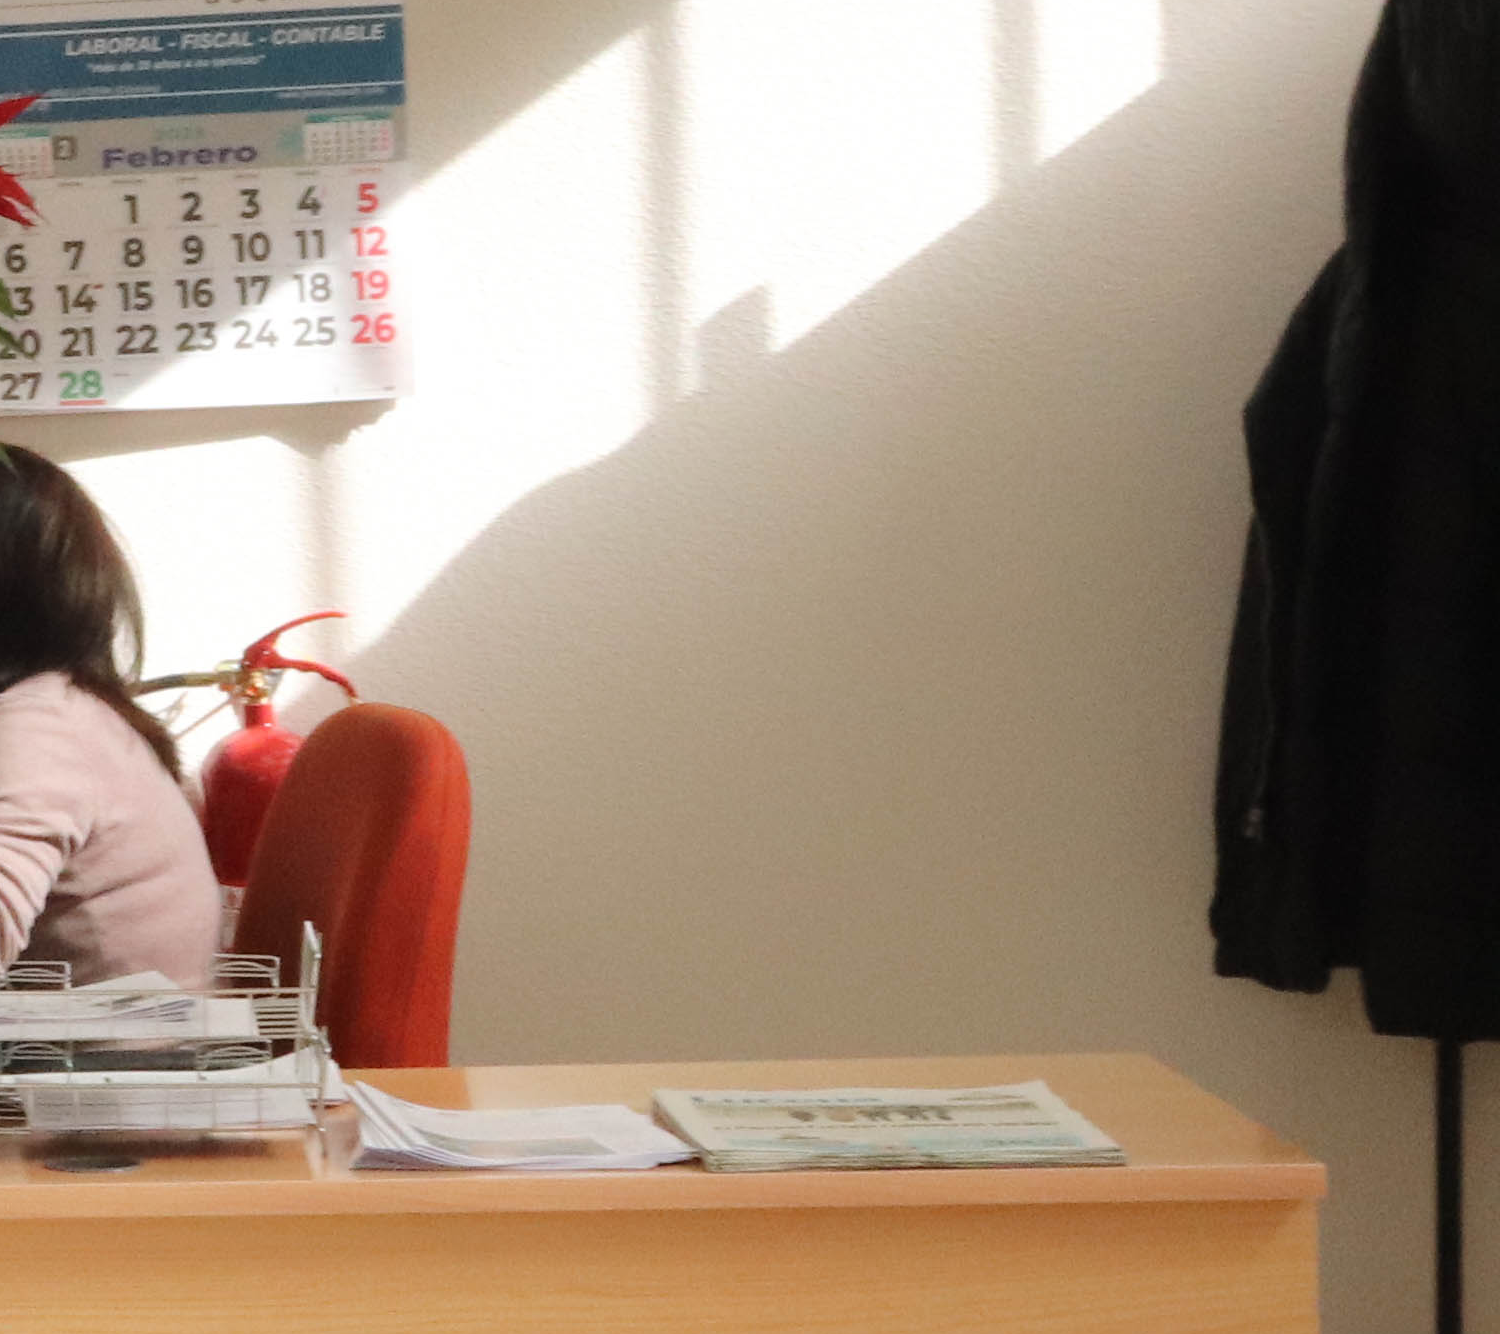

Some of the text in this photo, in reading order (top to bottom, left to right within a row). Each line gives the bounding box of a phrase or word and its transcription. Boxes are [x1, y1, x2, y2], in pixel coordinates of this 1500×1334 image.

[65, 35, 164, 57] LABORAL
[180, 29, 254, 50] FISCAL
[270, 22, 386, 46] CONTABLE
[103, 145, 258, 169] Febrero
[124, 183, 379, 224] 1 2 3 4 5
[5, 226, 389, 274] 6 7 8 9 10 11 12
[56, 283, 98, 315] 14
[117, 281, 154, 312] 15
[175, 278, 214, 309] 16
[235, 275, 271, 306] 17
[295, 273, 332, 303] 18
[352, 270, 390, 301] 19
[61, 326, 95, 357] 21
[116, 324, 159, 356] 22
[176, 321, 217, 353] 23
[232, 319, 279, 350] 24
[294, 317, 337, 348] 25
[350, 313, 396, 345] 26
[0, 370, 104, 400] 27 28
